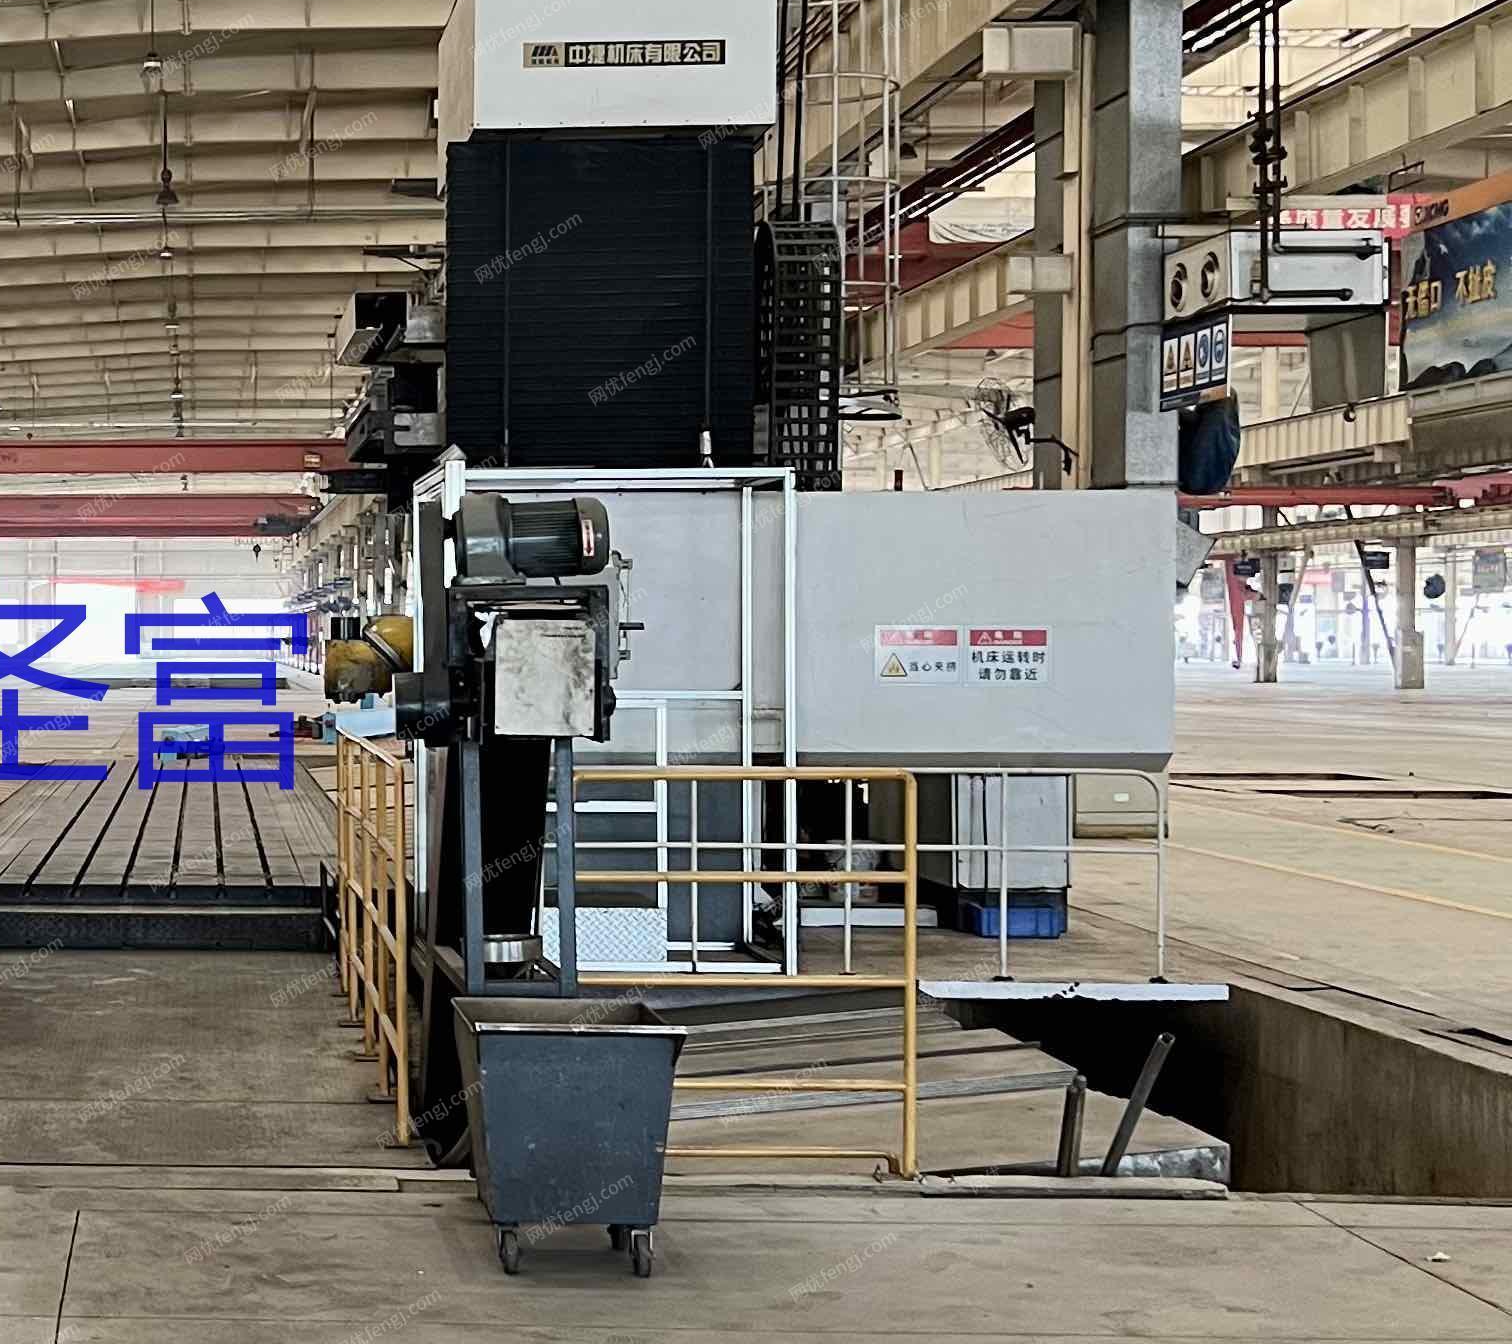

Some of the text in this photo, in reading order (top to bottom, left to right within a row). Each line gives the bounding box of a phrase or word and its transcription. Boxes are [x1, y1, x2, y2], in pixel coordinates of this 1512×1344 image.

[568, 42, 721, 65] 中捷机床有限公司
[971, 650, 1046, 665] 机床运转时
[978, 667, 1038, 681] 请勿靠近
